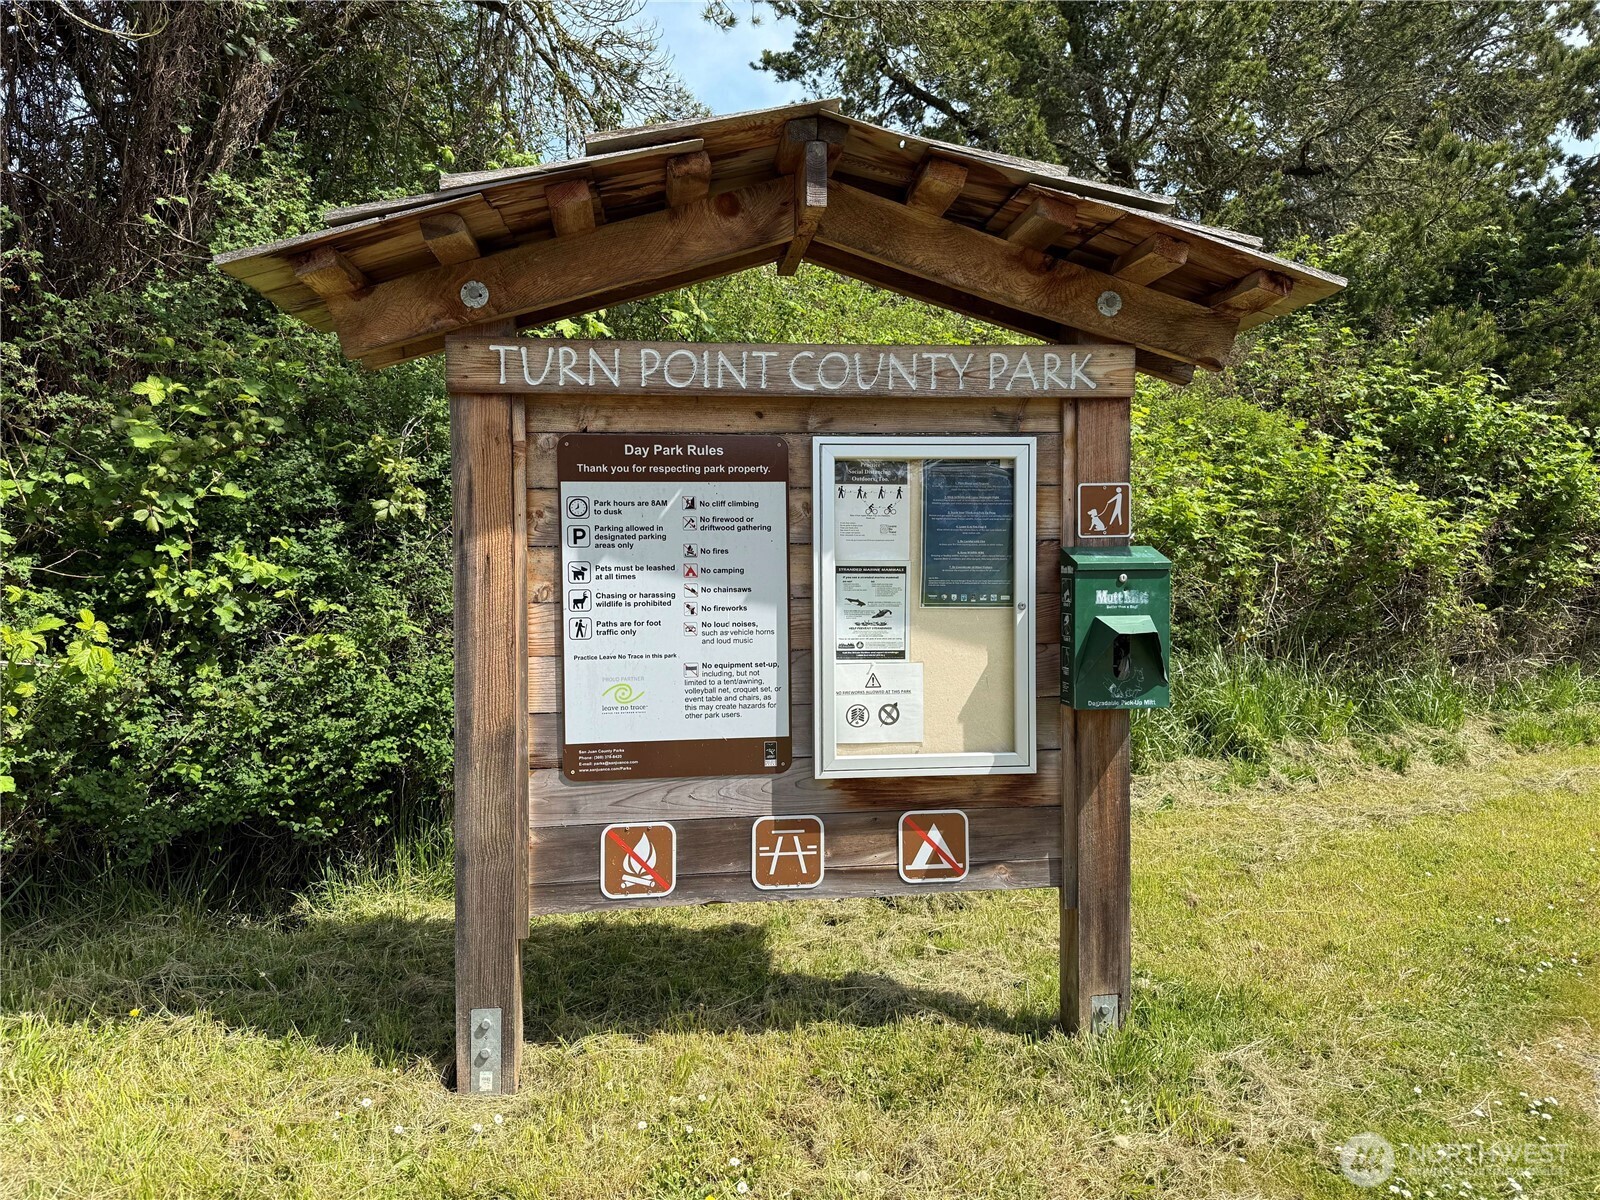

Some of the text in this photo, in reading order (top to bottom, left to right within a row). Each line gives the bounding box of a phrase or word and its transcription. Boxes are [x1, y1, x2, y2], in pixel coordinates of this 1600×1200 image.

[489, 345, 1096, 390] TURN POINT COUNTY PARK
[624, 444, 724, 456] Day Park Rules
[577, 463, 771, 476] Thank you for respecting park property.
[573, 528, 586, 544] P
[1096, 590, 1123, 604] Mutt
[724, 678, 764, 686] tent/awning,
